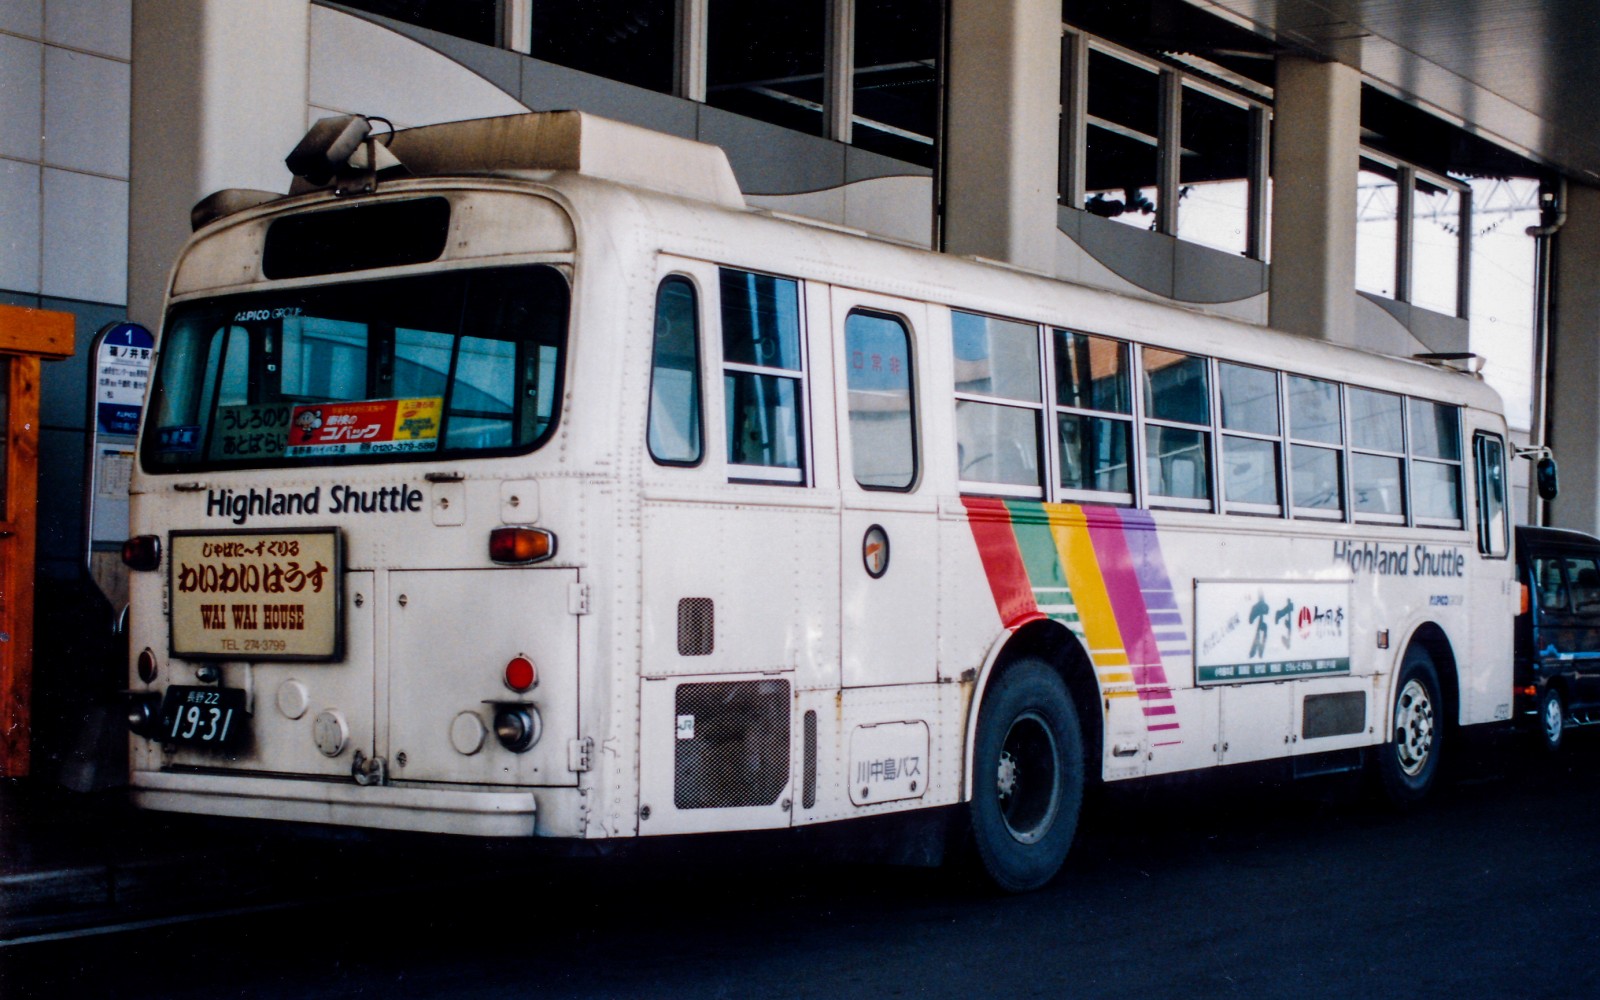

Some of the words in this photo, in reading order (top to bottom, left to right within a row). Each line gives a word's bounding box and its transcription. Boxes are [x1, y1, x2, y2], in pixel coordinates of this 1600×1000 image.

[233, 310, 270, 322] ALPICO
[125, 329, 133, 345] 1
[223, 407, 290, 430] うしろのり
[319, 424, 382, 442] コバック
[206, 486, 321, 525] Highland
[328, 483, 423, 515] Shuttle
[1333, 540, 1408, 576] Highland
[1412, 544, 1464, 577] Shuttle
[178, 560, 329, 594] わいわいはうす
[200, 604, 226, 630] WAI
[231, 604, 258, 630] WAI
[263, 604, 305, 630] HOUSE
[220, 639, 240, 651] TEL
[243, 639, 287, 651] 274-3799
[171, 705, 233, 742] 19-31
[678, 719, 694, 731] JR
[856, 756, 921, 784] 川中島バス
